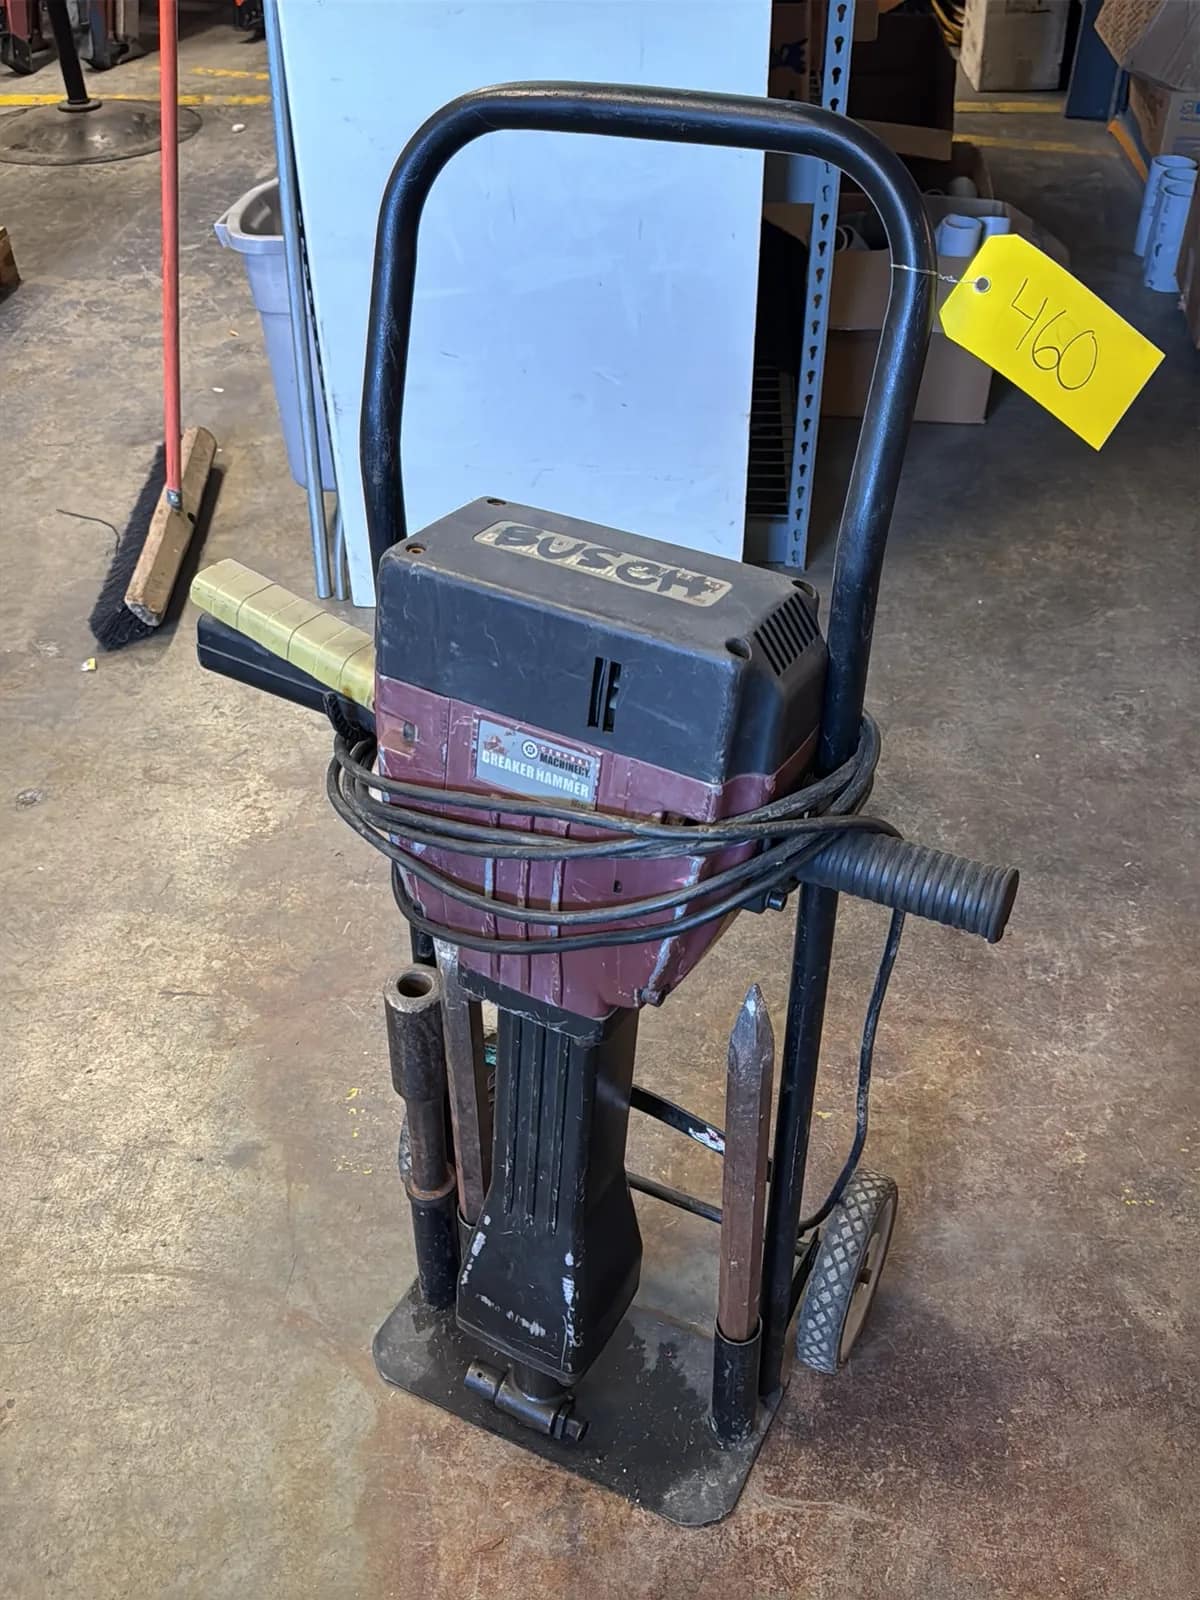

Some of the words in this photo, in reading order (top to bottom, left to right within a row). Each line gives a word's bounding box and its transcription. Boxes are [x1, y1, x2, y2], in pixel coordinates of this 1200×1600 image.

[1010, 277, 1098, 391] 460
[494, 525, 720, 599] BUSCH
[535, 767, 589, 798] HAMMER
